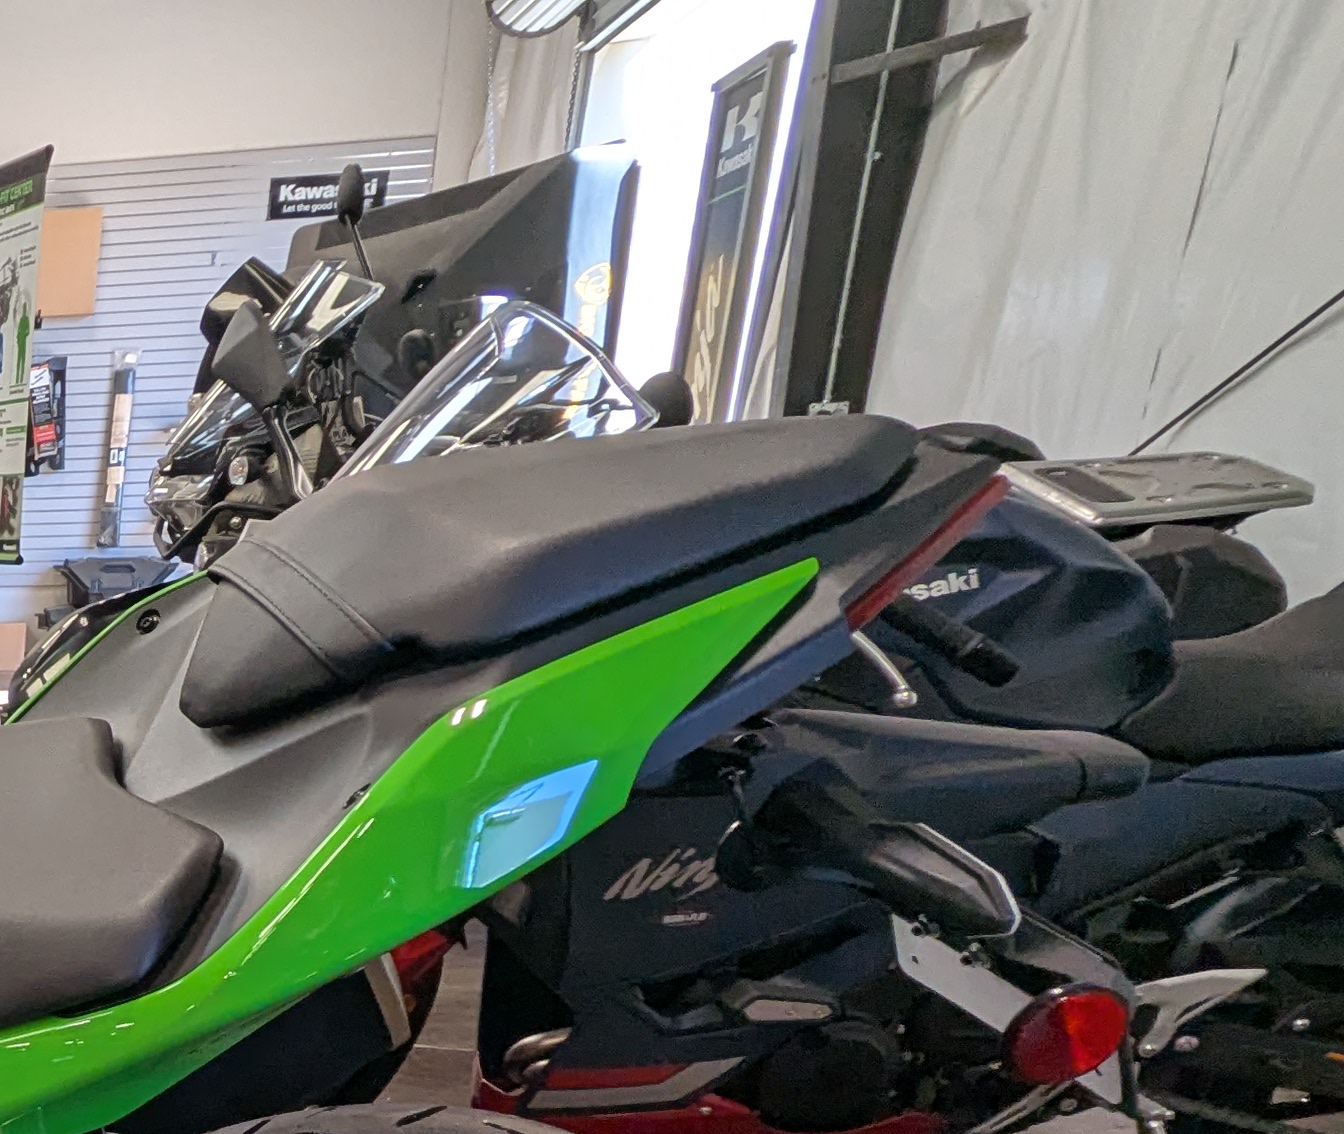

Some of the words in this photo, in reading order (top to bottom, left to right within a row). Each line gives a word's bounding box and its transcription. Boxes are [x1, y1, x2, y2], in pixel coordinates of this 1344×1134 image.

[282, 203, 296, 214] Let
[297, 203, 311, 212] the
[311, 201, 333, 213] good
